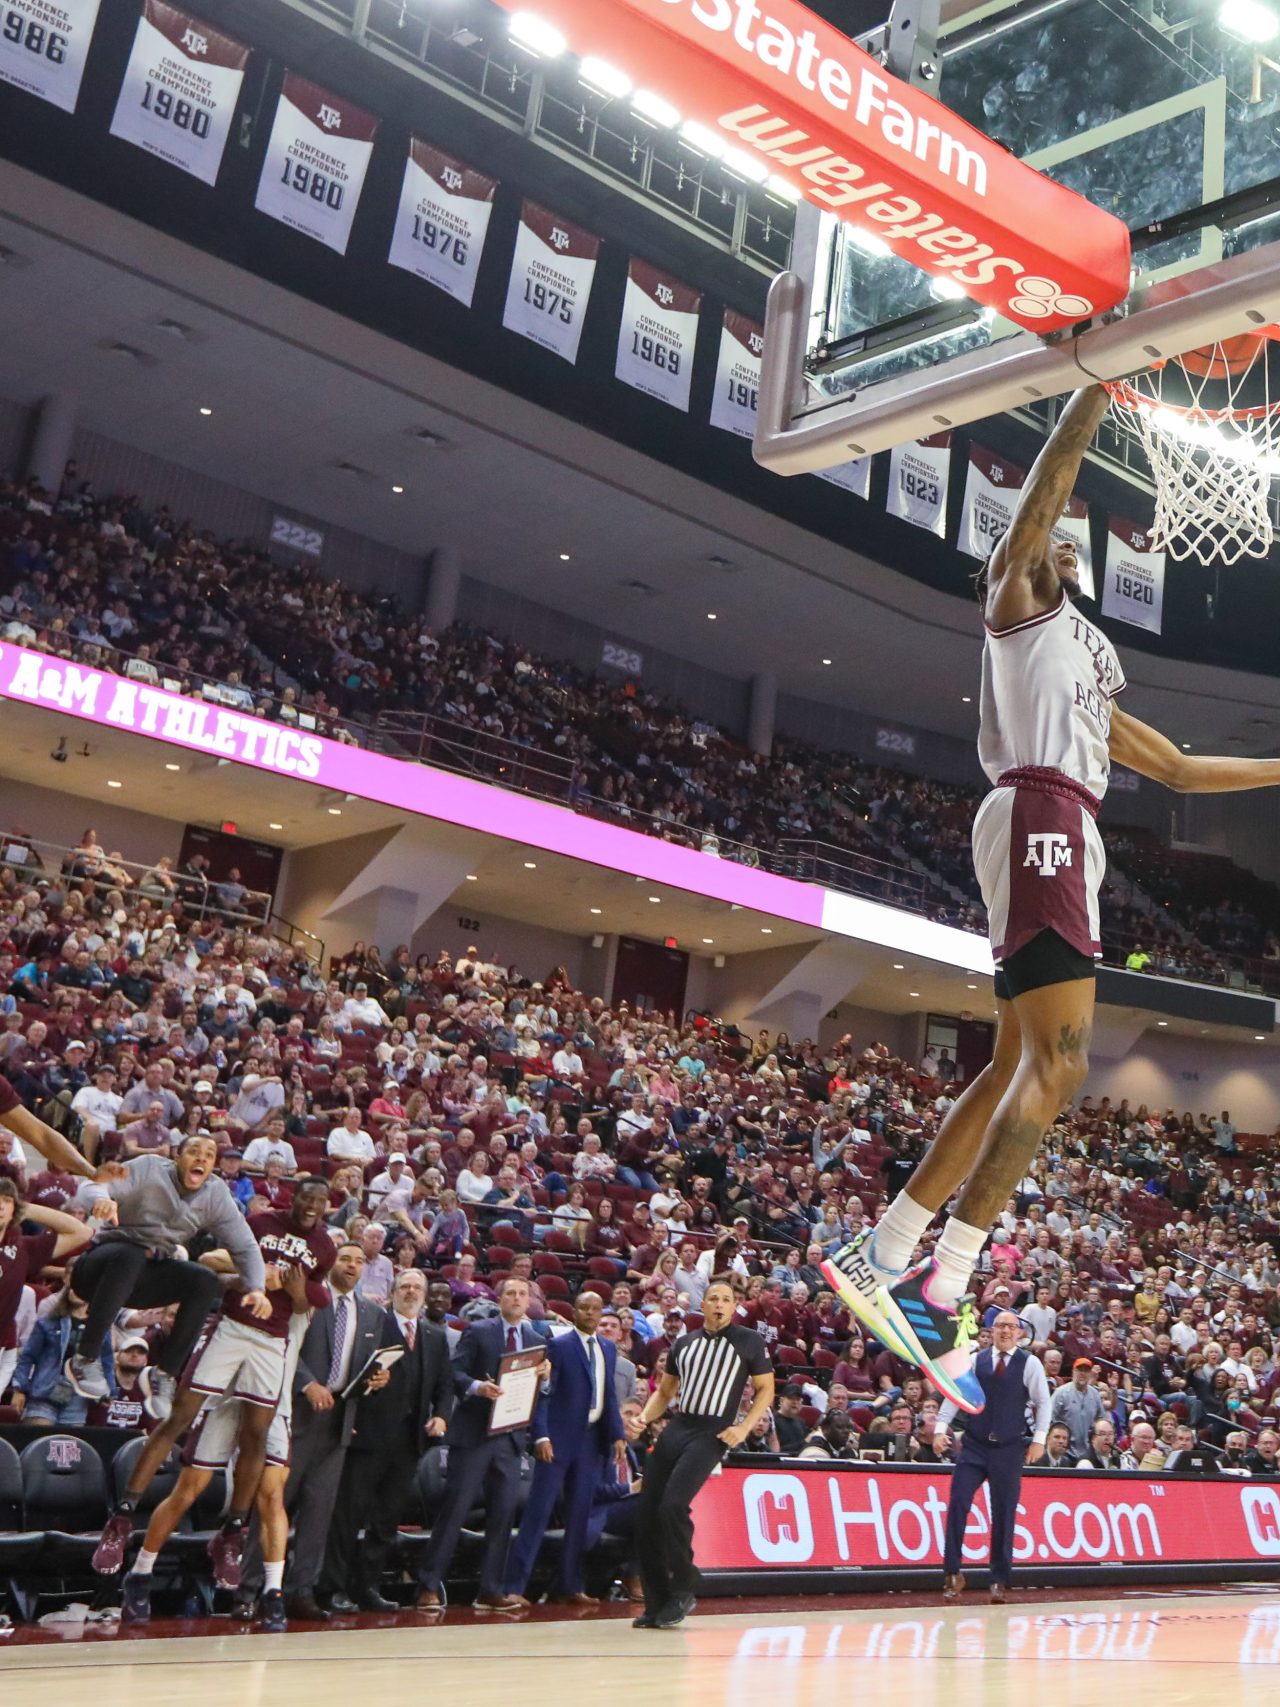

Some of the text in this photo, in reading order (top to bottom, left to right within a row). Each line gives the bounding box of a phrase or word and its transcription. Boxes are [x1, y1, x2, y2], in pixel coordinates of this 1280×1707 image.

[26, 0, 69, 20] ERENCE
[3, 10, 68, 64] 986
[158, 64, 212, 97] TOURNAMENT
[162, 57, 212, 88] CONFERENCE
[149, 69, 216, 109] CHAMPIONSHIP
[141, 81, 211, 140] 1980
[288, 145, 349, 182] CHAMPIONSHIP
[294, 138, 346, 171] CONFERENCE
[281, 157, 344, 211] 1980
[417, 203, 472, 239] CHAMPIONSHIP
[422, 198, 469, 229] CONFERENCE
[412, 214, 469, 266] 1976
[527, 267, 578, 297] CHAMPIONSHIP
[532, 260, 575, 288] CONFERENCE
[524, 278, 576, 324] 1975
[635, 321, 683, 350] CHAMPIONSHIP
[640, 315, 680, 340] CONFERENCE
[631, 331, 681, 376] 1969
[901, 459, 940, 481] CHAMPIONSHIP
[904, 453, 936, 474] CONFERENCE
[900, 469, 939, 505] 1923
[977, 492, 1008, 511] CONFERENCE
[975, 498, 1012, 520] CHAMPIONSHIP
[272, 520, 322, 555] 222
[1117, 566, 1155, 584] CHAMPIONSHIP
[1120, 559, 1153, 577] CONFERENCE
[1115, 574, 1153, 605] 1920
[602, 645, 641, 673] 223
[8, 653, 323, 778] A&M ATHLETICS
[1109, 773, 1138, 790] 25
